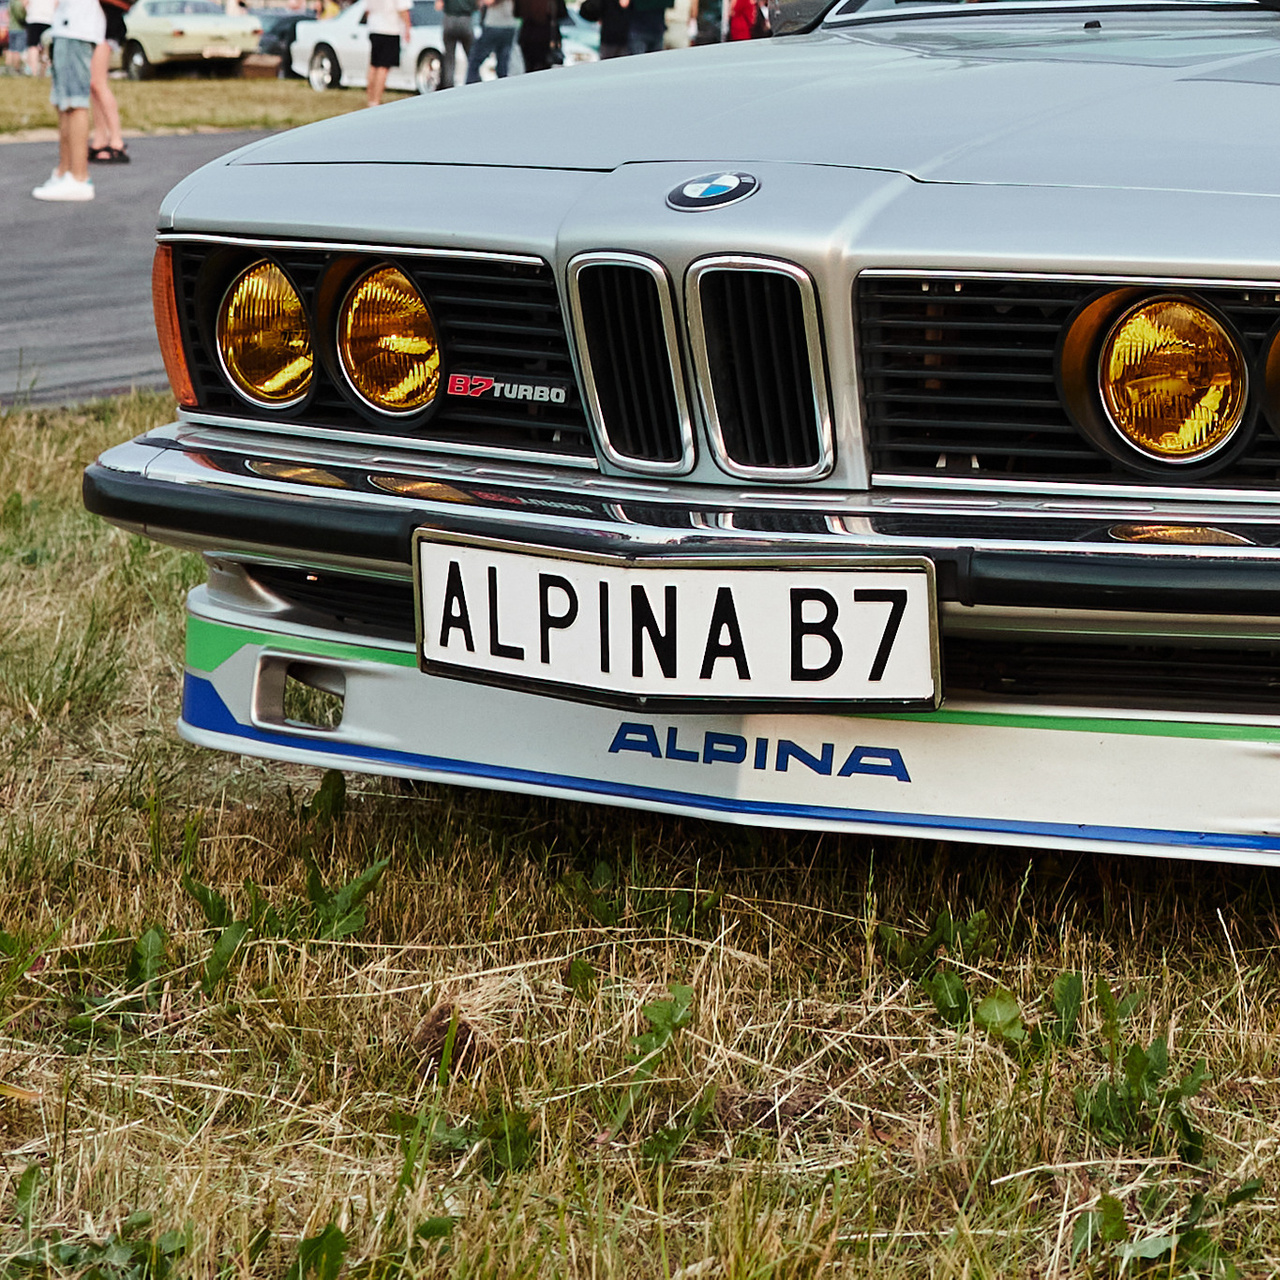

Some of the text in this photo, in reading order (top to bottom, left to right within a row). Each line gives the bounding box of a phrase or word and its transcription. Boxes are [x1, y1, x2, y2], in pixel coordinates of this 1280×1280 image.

[439, 560, 909, 682] ALPINA B7
[608, 721, 912, 783] ALPINA
